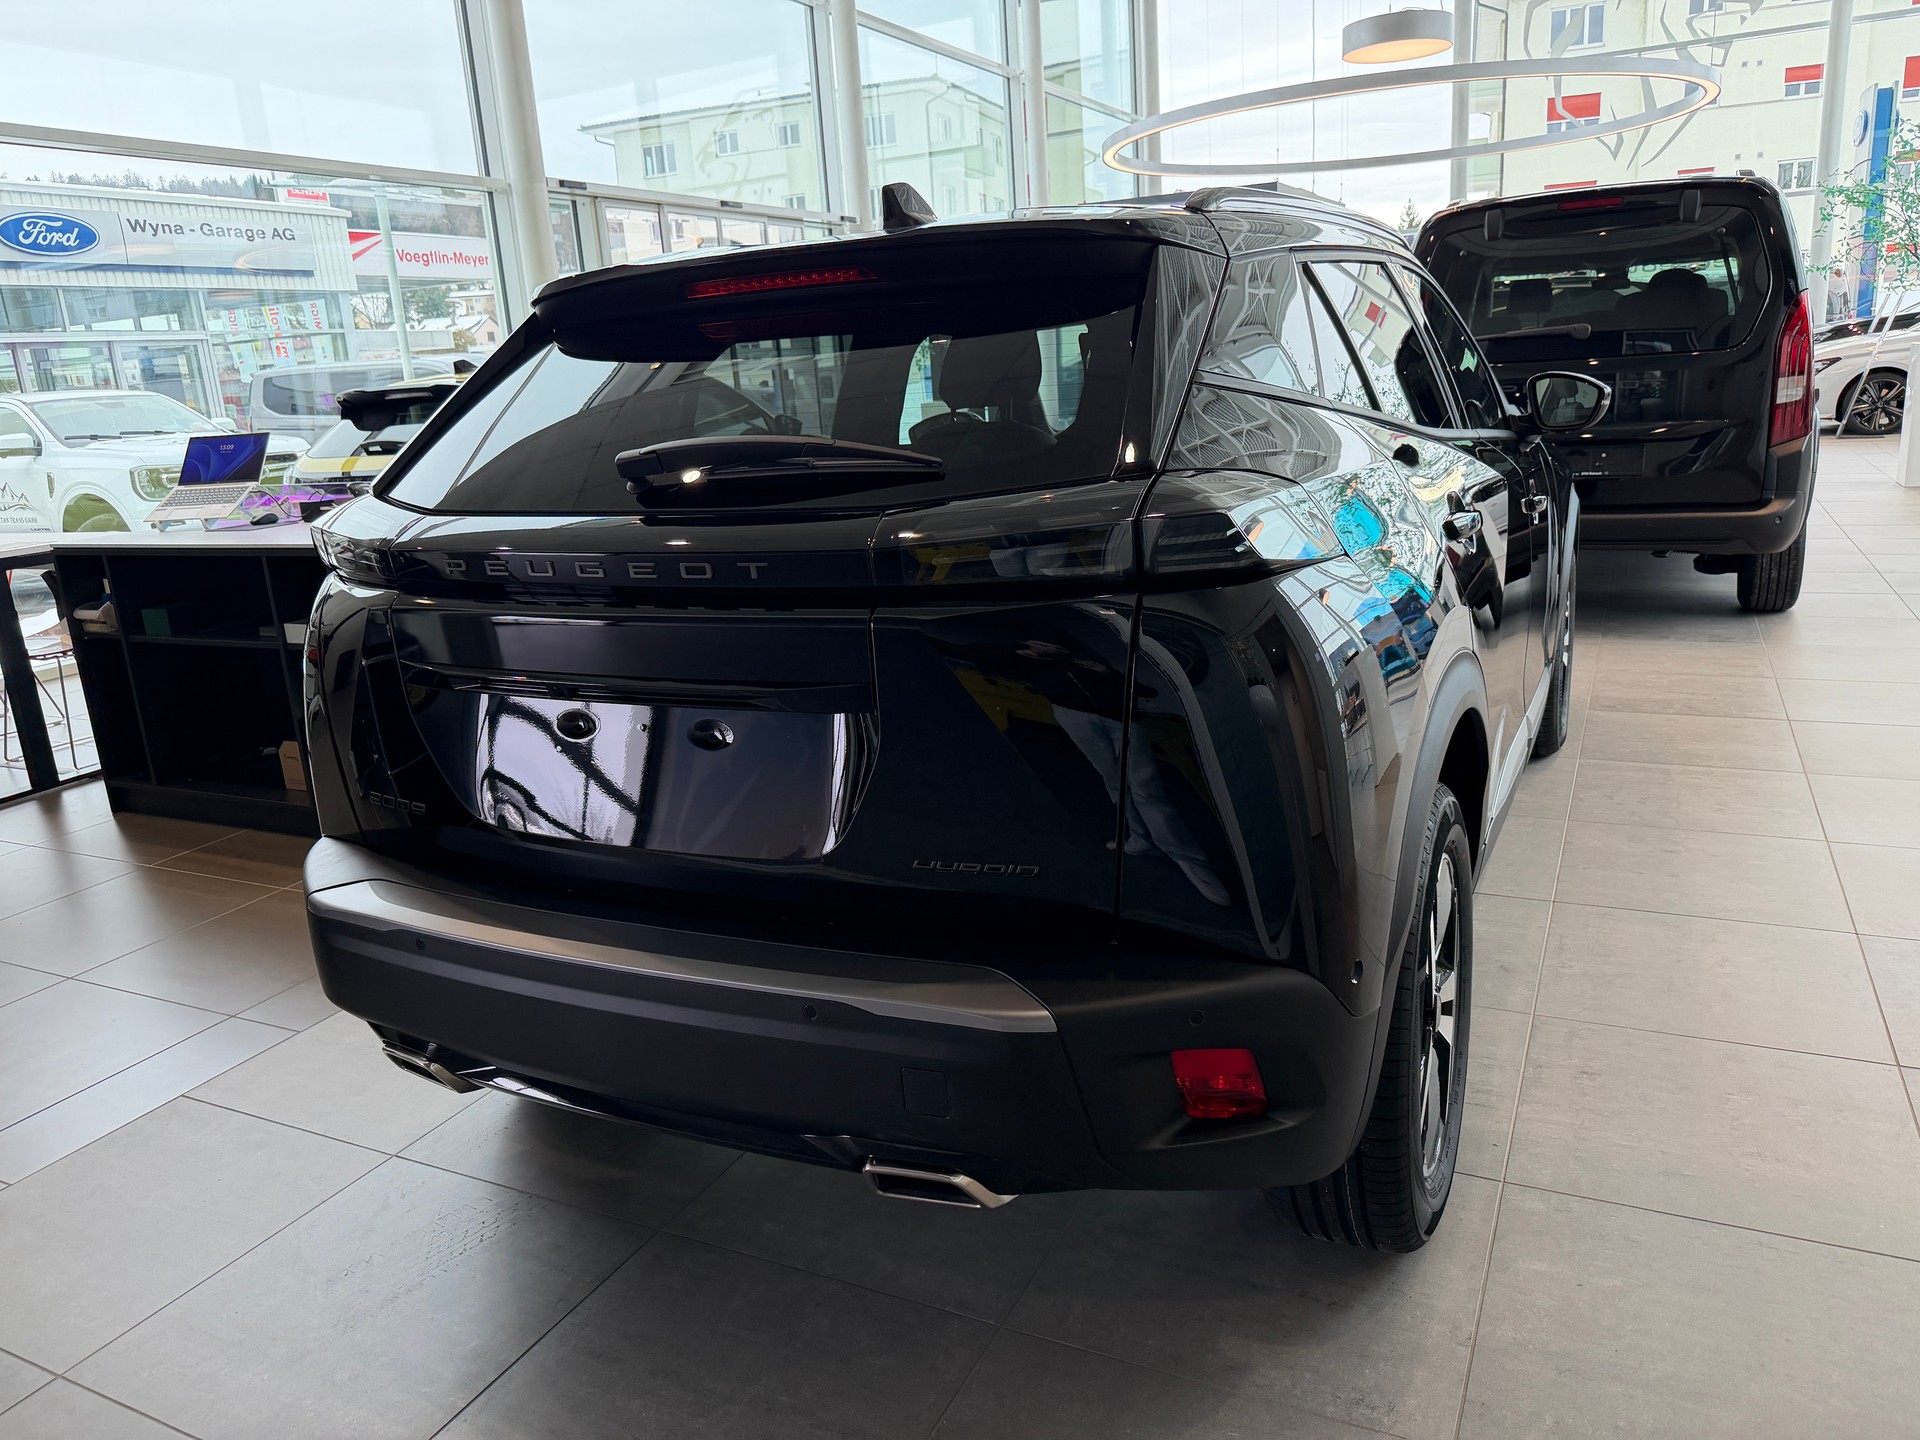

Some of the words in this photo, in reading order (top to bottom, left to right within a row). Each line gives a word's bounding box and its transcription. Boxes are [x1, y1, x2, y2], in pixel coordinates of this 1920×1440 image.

[18, 218, 80, 248] Ford
[126, 218, 185, 237] Wyna
[199, 222, 267, 242] Garage
[271, 227, 296, 241] AG
[395, 248, 489, 268] Voegtlin-Meyer
[220, 443, 235, 451] 13:09
[443, 558, 769, 581] PEUGEOT
[369, 790, 426, 815] 2008
